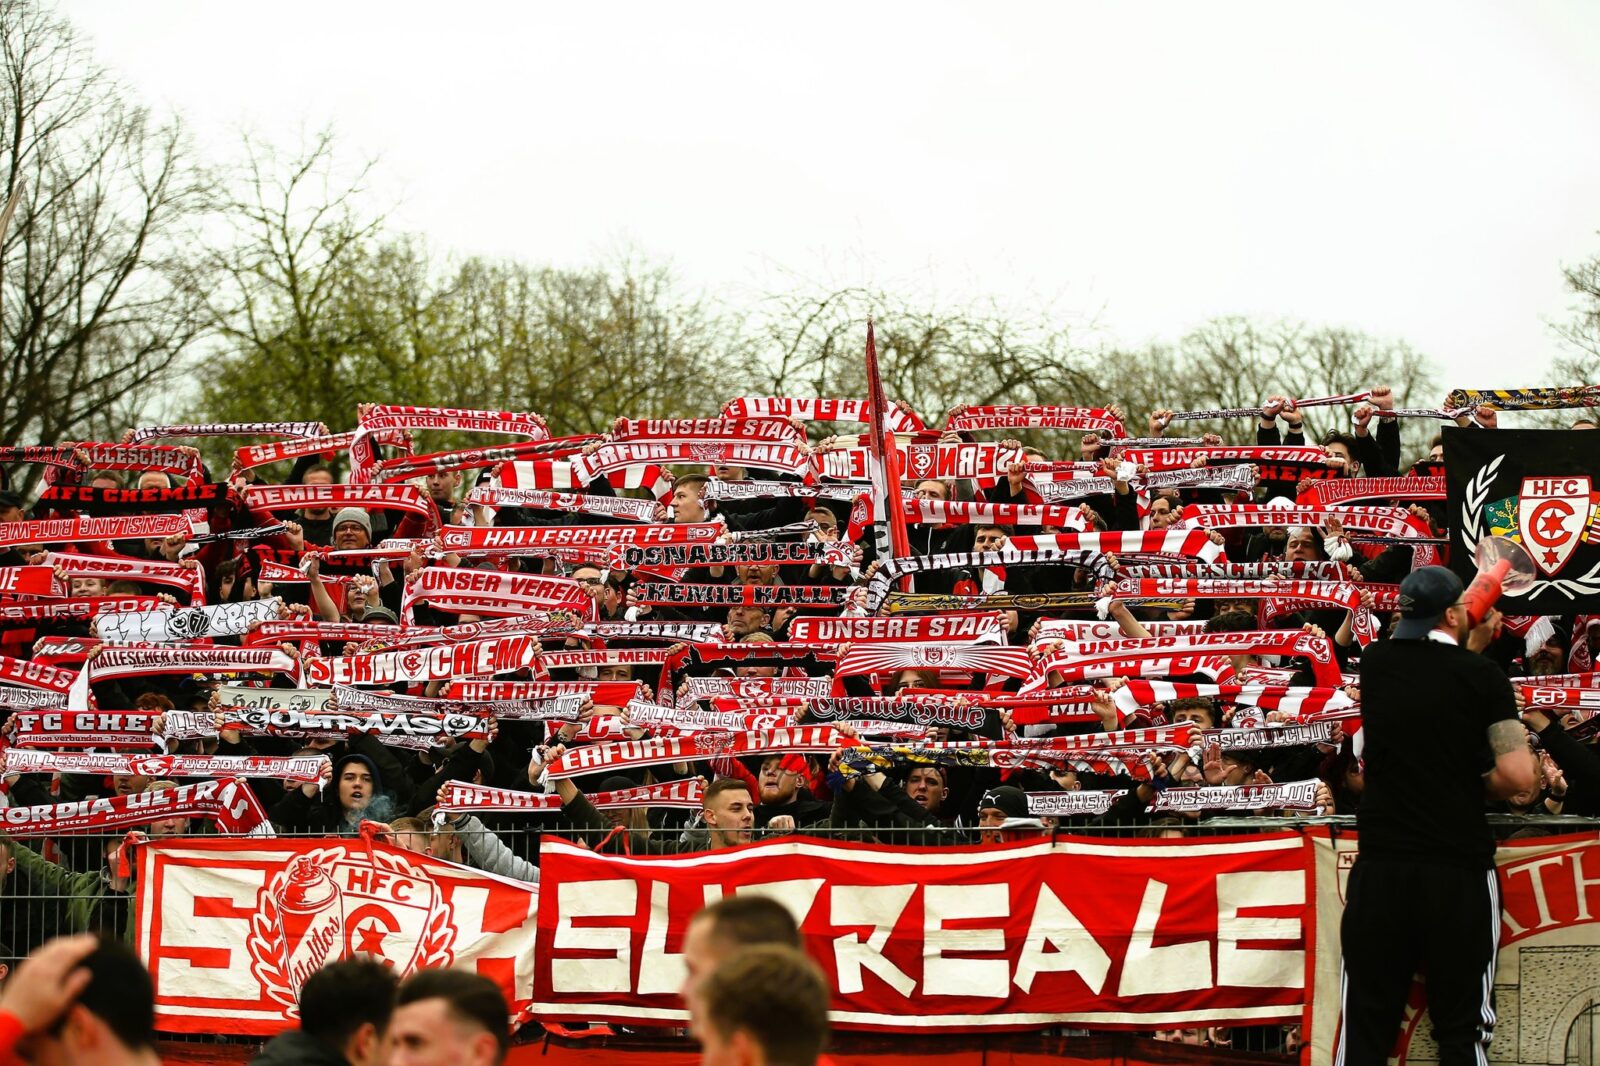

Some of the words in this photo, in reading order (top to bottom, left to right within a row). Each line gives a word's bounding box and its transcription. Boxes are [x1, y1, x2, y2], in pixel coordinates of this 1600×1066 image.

[363, 416, 397, 431] MEIN
[398, 416, 448, 429] VEREIN
[457, 418, 500, 432] MEINE
[502, 420, 538, 436] LIEBE
[648, 418, 738, 435] UNSERE
[974, 417, 1029, 430] VEREIN
[1040, 417, 1084, 430] MEINE
[588, 442, 684, 472] ERFURT
[102, 482, 218, 503] CHEMIE
[1532, 479, 1579, 496] HFC
[1196, 512, 1237, 527] EIN
[1244, 511, 1322, 525] LEBEN
[1340, 514, 1396, 531] ANG
[484, 529, 636, 547] HALLESCHER
[644, 527, 677, 543] FC
[625, 541, 824, 566] OSNABRUECK
[1124, 561, 1294, 580] HALLESCHER
[1302, 560, 1336, 578] FC
[422, 569, 501, 593] UNSER
[511, 576, 588, 606] VEREIN
[818, 618, 920, 641] UNSERE
[1079, 636, 1177, 656] UNSER
[93, 650, 170, 670] HALLESCHER
[173, 650, 272, 664] FUSSBALLCLUB
[462, 683, 504, 701] HFC
[54, 734, 103, 743] verbunden
[561, 738, 682, 771] ERFURT
[0, 797, 114, 825] ORDIA
[346, 868, 414, 901] HFC
